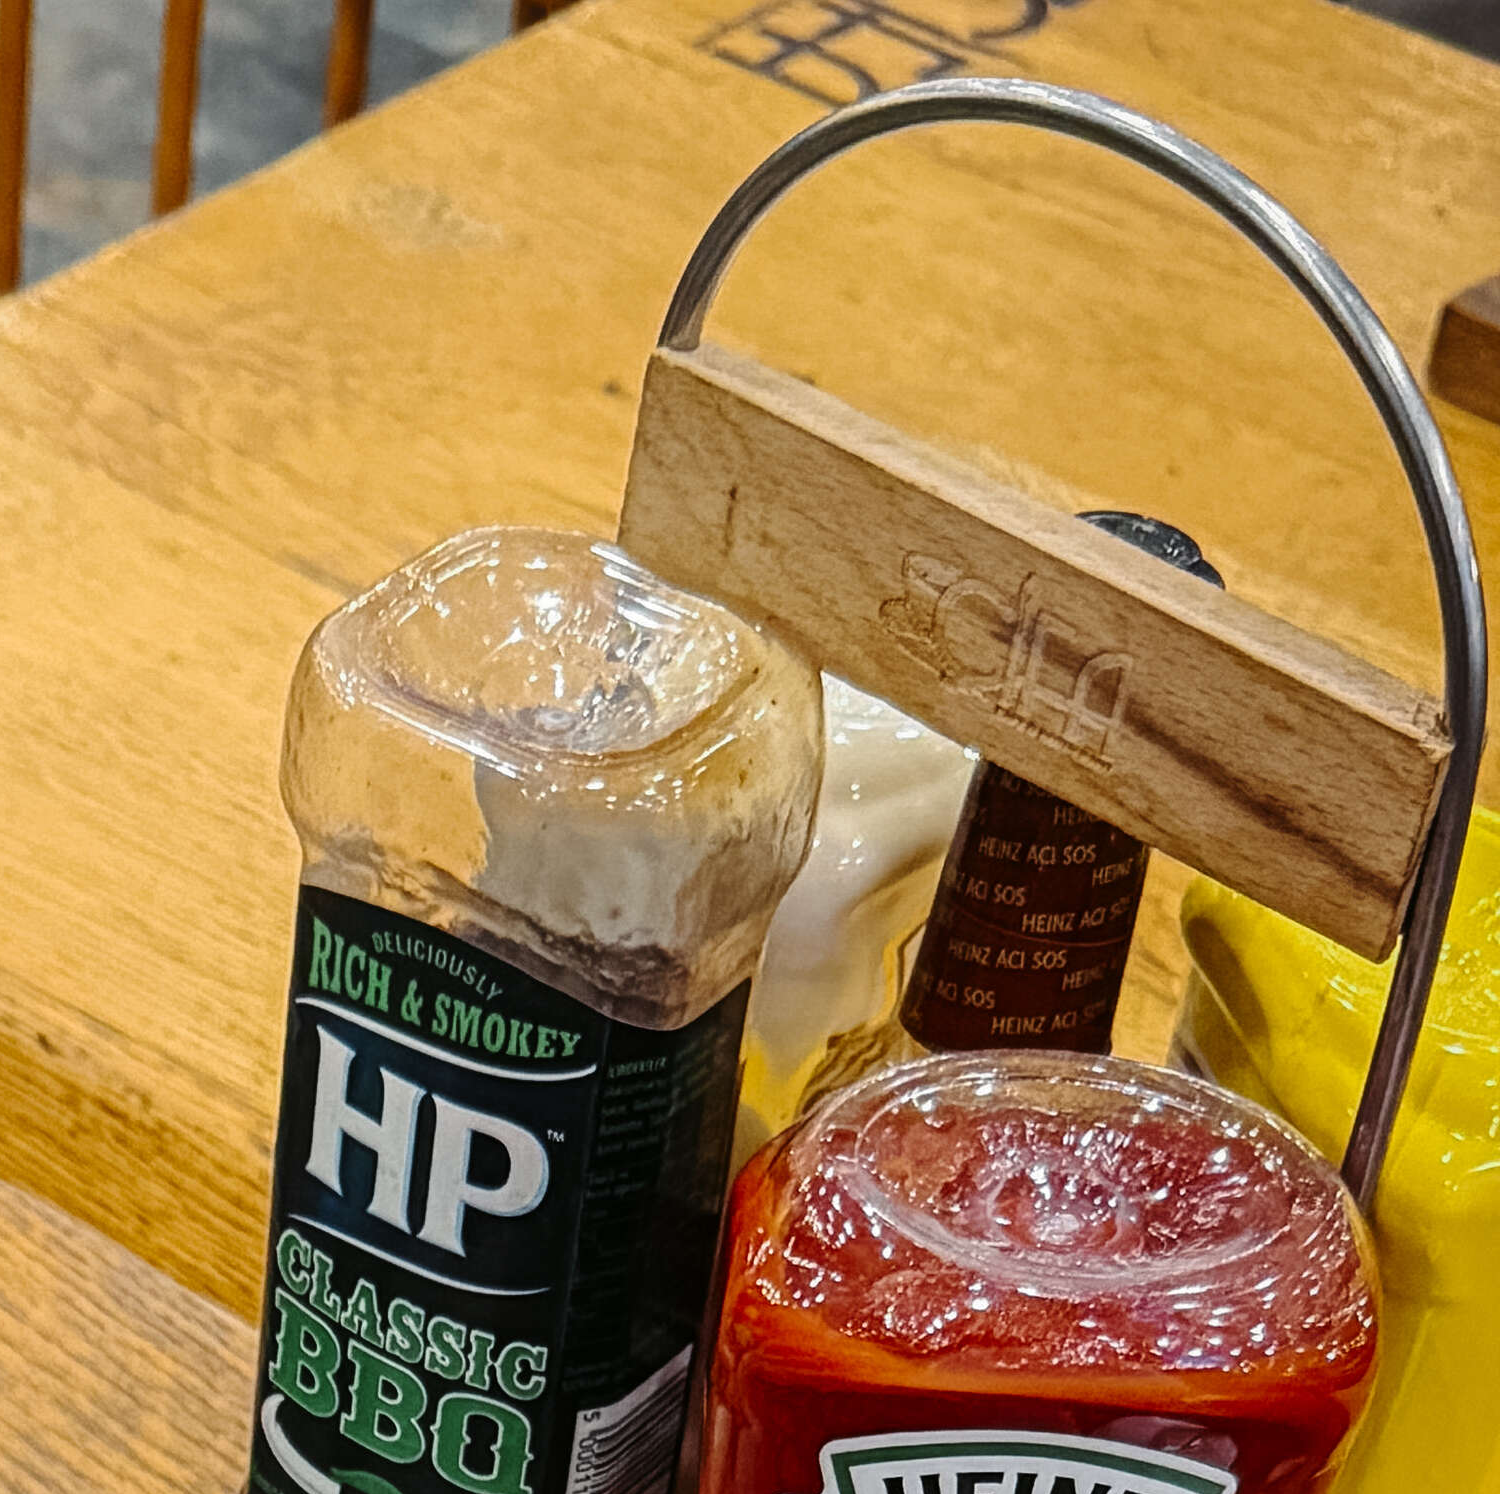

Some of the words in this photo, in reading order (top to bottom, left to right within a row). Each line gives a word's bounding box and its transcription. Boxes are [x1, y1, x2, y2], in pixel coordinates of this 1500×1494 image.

[1062, 843, 1097, 865] SOS
[993, 883, 1028, 906] SOS
[1021, 912, 1075, 934] HEINZ
[370, 927, 503, 1000] DELICIOUSLY
[1031, 949, 1068, 970] SOS
[307, 916, 391, 1011] RICH
[400, 977, 424, 1026] &
[430, 991, 582, 1060] SMOKEY
[963, 986, 996, 1009] SOS
[990, 1015, 1045, 1036] HEINZ
[303, 1022, 550, 1260] HP
[275, 1227, 548, 1401] CLASSIC
[583, 1411, 601, 1423] 5
